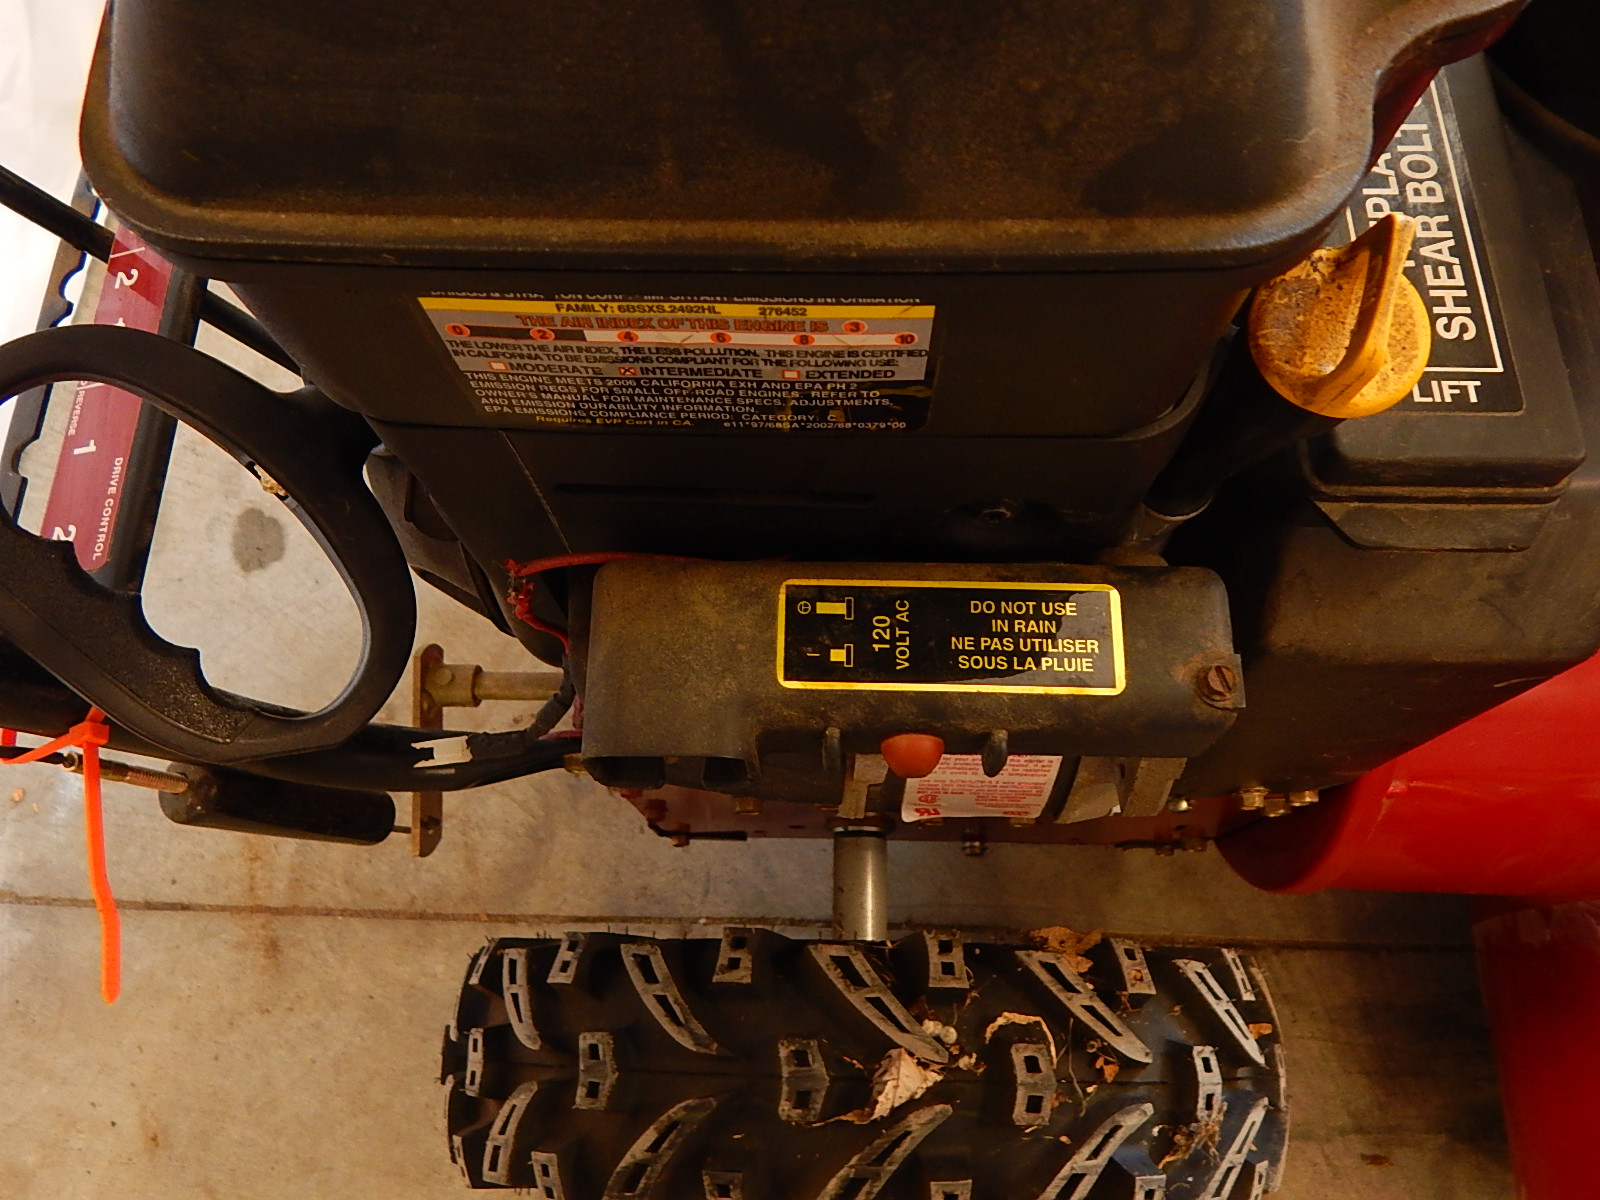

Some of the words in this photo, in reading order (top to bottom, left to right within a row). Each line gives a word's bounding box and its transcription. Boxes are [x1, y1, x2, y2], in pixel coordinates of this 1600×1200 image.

[1395, 123, 1445, 203] BOLT
[114, 268, 139, 289] 2
[1414, 214, 1477, 341] SHEAR
[555, 303, 614, 313] FAMILY:
[759, 307, 807, 316] 276452
[515, 315, 557, 326] THE
[561, 316, 594, 328] AIR
[595, 317, 656, 329] INDEX
[658, 317, 684, 329] OF
[685, 318, 730, 330] THIS
[734, 319, 806, 332] ENGINE
[810, 320, 829, 332] IS
[446, 340, 472, 349] THE
[475, 341, 522, 351] LOWER
[523, 344, 550, 353] THE
[553, 344, 574, 353] AIR
[619, 346, 645, 355] THE
[648, 347, 681, 355] LESS
[764, 349, 793, 358] THIS
[796, 350, 845, 358] ENGINE
[847, 350, 859, 358] IS
[862, 350, 928, 358] CERTIFIED
[467, 350, 543, 361] CALIFORNIA
[543, 353, 563, 362] TO
[565, 354, 583, 363] BE
[584, 355, 653, 364] EMISSIONS
[656, 356, 730, 365] COMPLIANT
[733, 357, 759, 366] FOR
[761, 358, 787, 367] THE
[790, 359, 866, 367] FOLLOWING
[508, 362, 603, 375] MODERATE
[640, 366, 763, 378] INTERMEDIATE
[806, 370, 895, 379] EXTENDED
[463, 372, 497, 381] THIS
[499, 373, 553, 384] ENGINE
[555, 376, 602, 386] MEETS
[606, 379, 637, 387] 2006
[640, 379, 725, 388] CALIFORNIA
[729, 380, 757, 389] EXH
[761, 382, 790, 390] AND
[795, 382, 822, 390] EPA
[827, 382, 846, 390] PH
[469, 380, 536, 392] EMISSION
[539, 384, 578, 393] REGS
[580, 386, 610, 394] FOR
[613, 387, 660, 395] SMALL
[860, 390, 880, 398] TO
[540, 393, 600, 402] MANUAL
[602, 395, 630, 403] FOR
[634, 396, 732, 404] MAINTENANCE
[1412, 380, 1481, 403] LIFT
[481, 397, 509, 405] AND
[512, 398, 576, 409] EMISSION
[579, 402, 658, 411] DURABILITY
[484, 405, 512, 413] EPA
[514, 406, 587, 417] EMISSIONS
[589, 410, 677, 419] COMPLIANCE
[68, 390, 86, 437] REVERSE
[536, 415, 592, 424] Requires
[73, 439, 97, 455] 1
[107, 456, 124, 496] DRIVE
[92, 498, 114, 561] CONTROL
[895, 599, 910, 623] AC
[970, 600, 996, 614] DO
[1000, 601, 1037, 615] NOT
[1041, 602, 1077, 616] USE
[871, 615, 891, 652] 120
[991, 619, 1009, 632] IN
[1014, 619, 1057, 634] RAIN
[895, 627, 910, 670] VOLT
[951, 636, 975, 650] NE
[980, 637, 1014, 651] PAS
[1019, 638, 1099, 653] UTILISER
[958, 655, 1009, 670] SOUS
[1013, 656, 1037, 670] LA
[1041, 657, 1094, 672] PLUIE
